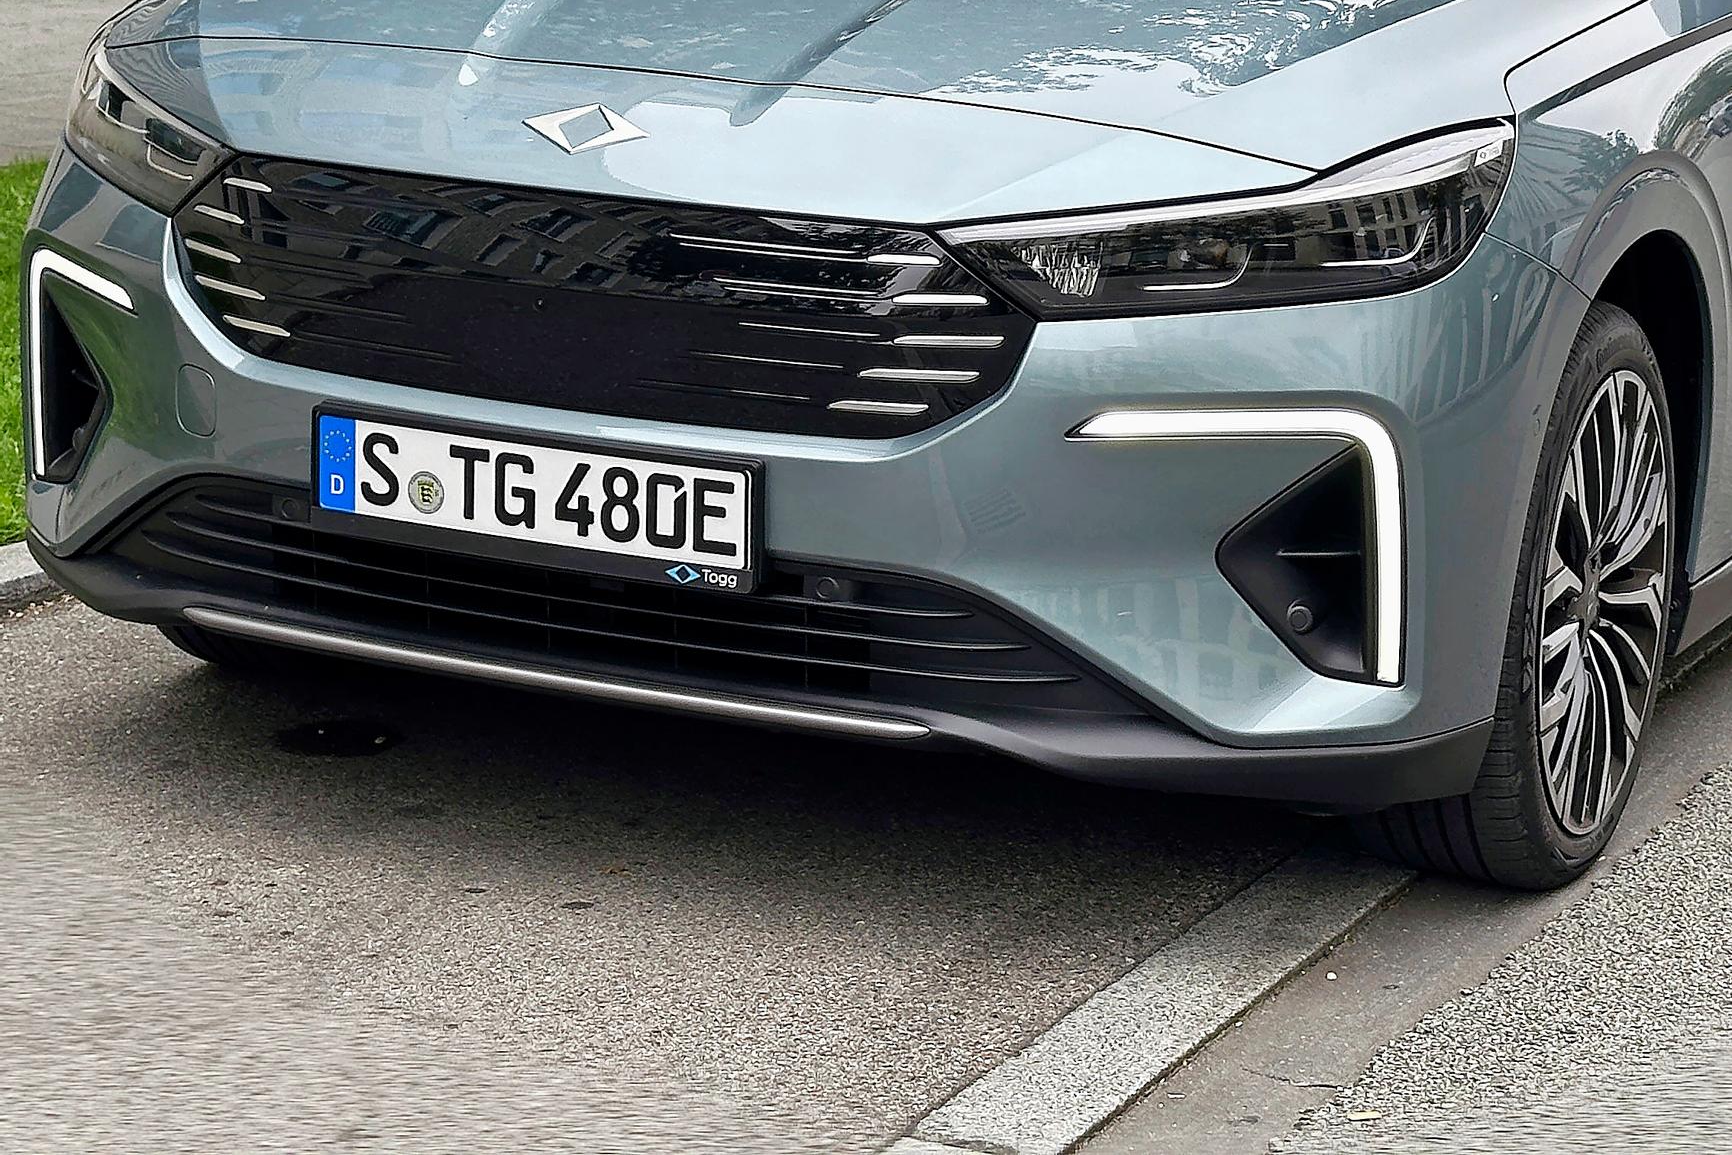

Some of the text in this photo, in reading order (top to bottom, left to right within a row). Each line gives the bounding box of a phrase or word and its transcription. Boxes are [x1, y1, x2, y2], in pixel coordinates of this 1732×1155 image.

[330, 474, 344, 495] D
[361, 432, 738, 557] S TG 480E
[701, 568, 738, 589] Togg
